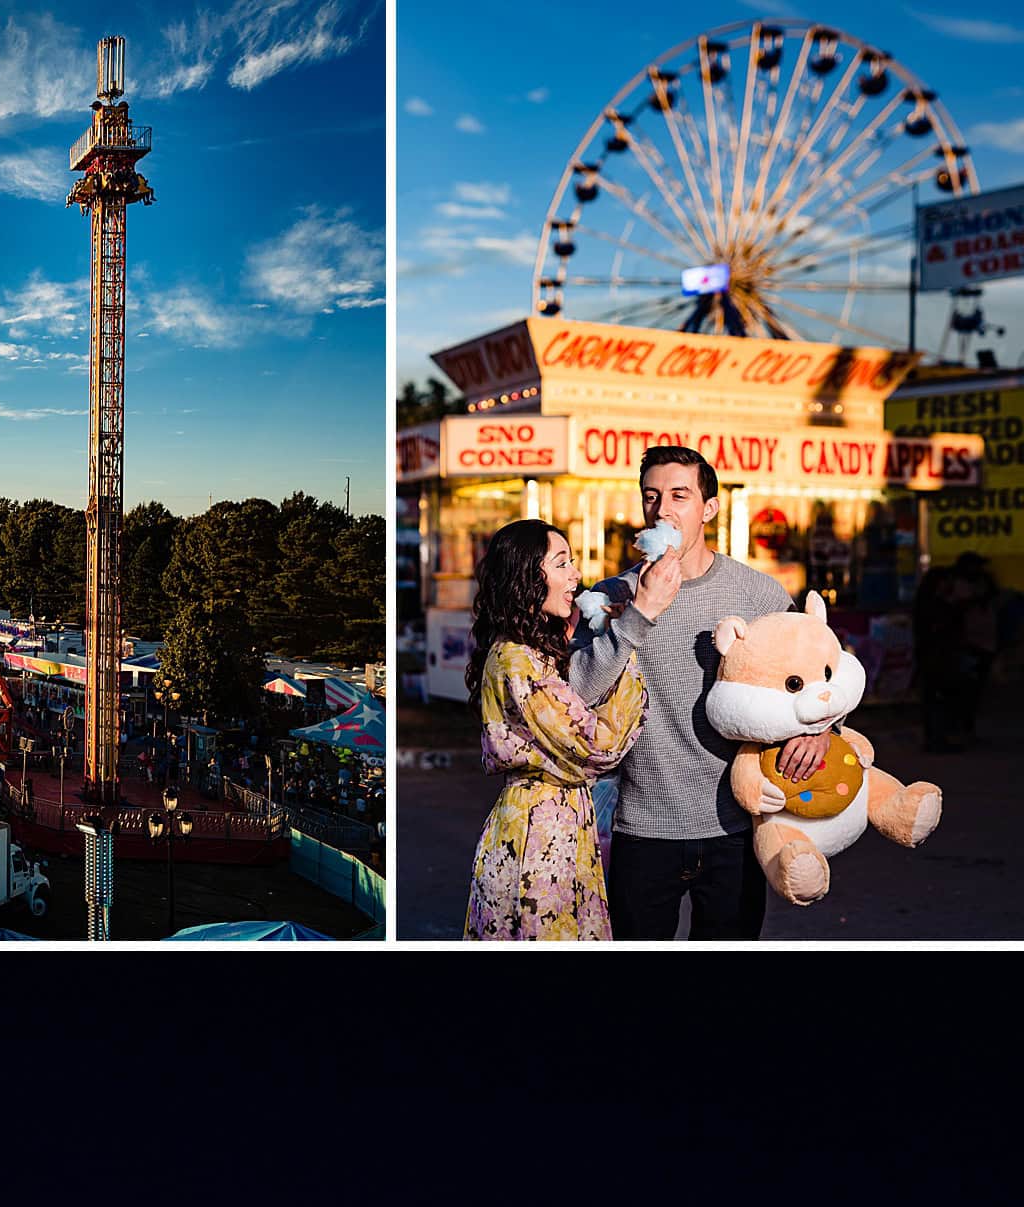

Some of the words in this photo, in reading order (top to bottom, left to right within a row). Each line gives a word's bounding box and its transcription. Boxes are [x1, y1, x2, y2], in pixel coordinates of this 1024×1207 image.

[542, 331, 656, 376] CARAMEL
[657, 345, 731, 380] CORN
[741, 349, 810, 384] COLD
[478, 425, 534, 443] SNO
[458, 449, 554, 467] CONES
[698, 435, 778, 474] CANDY
[801, 440, 878, 475] CANDY
[883, 443, 971, 480] APPLES
[937, 515, 1012, 539] CORN
